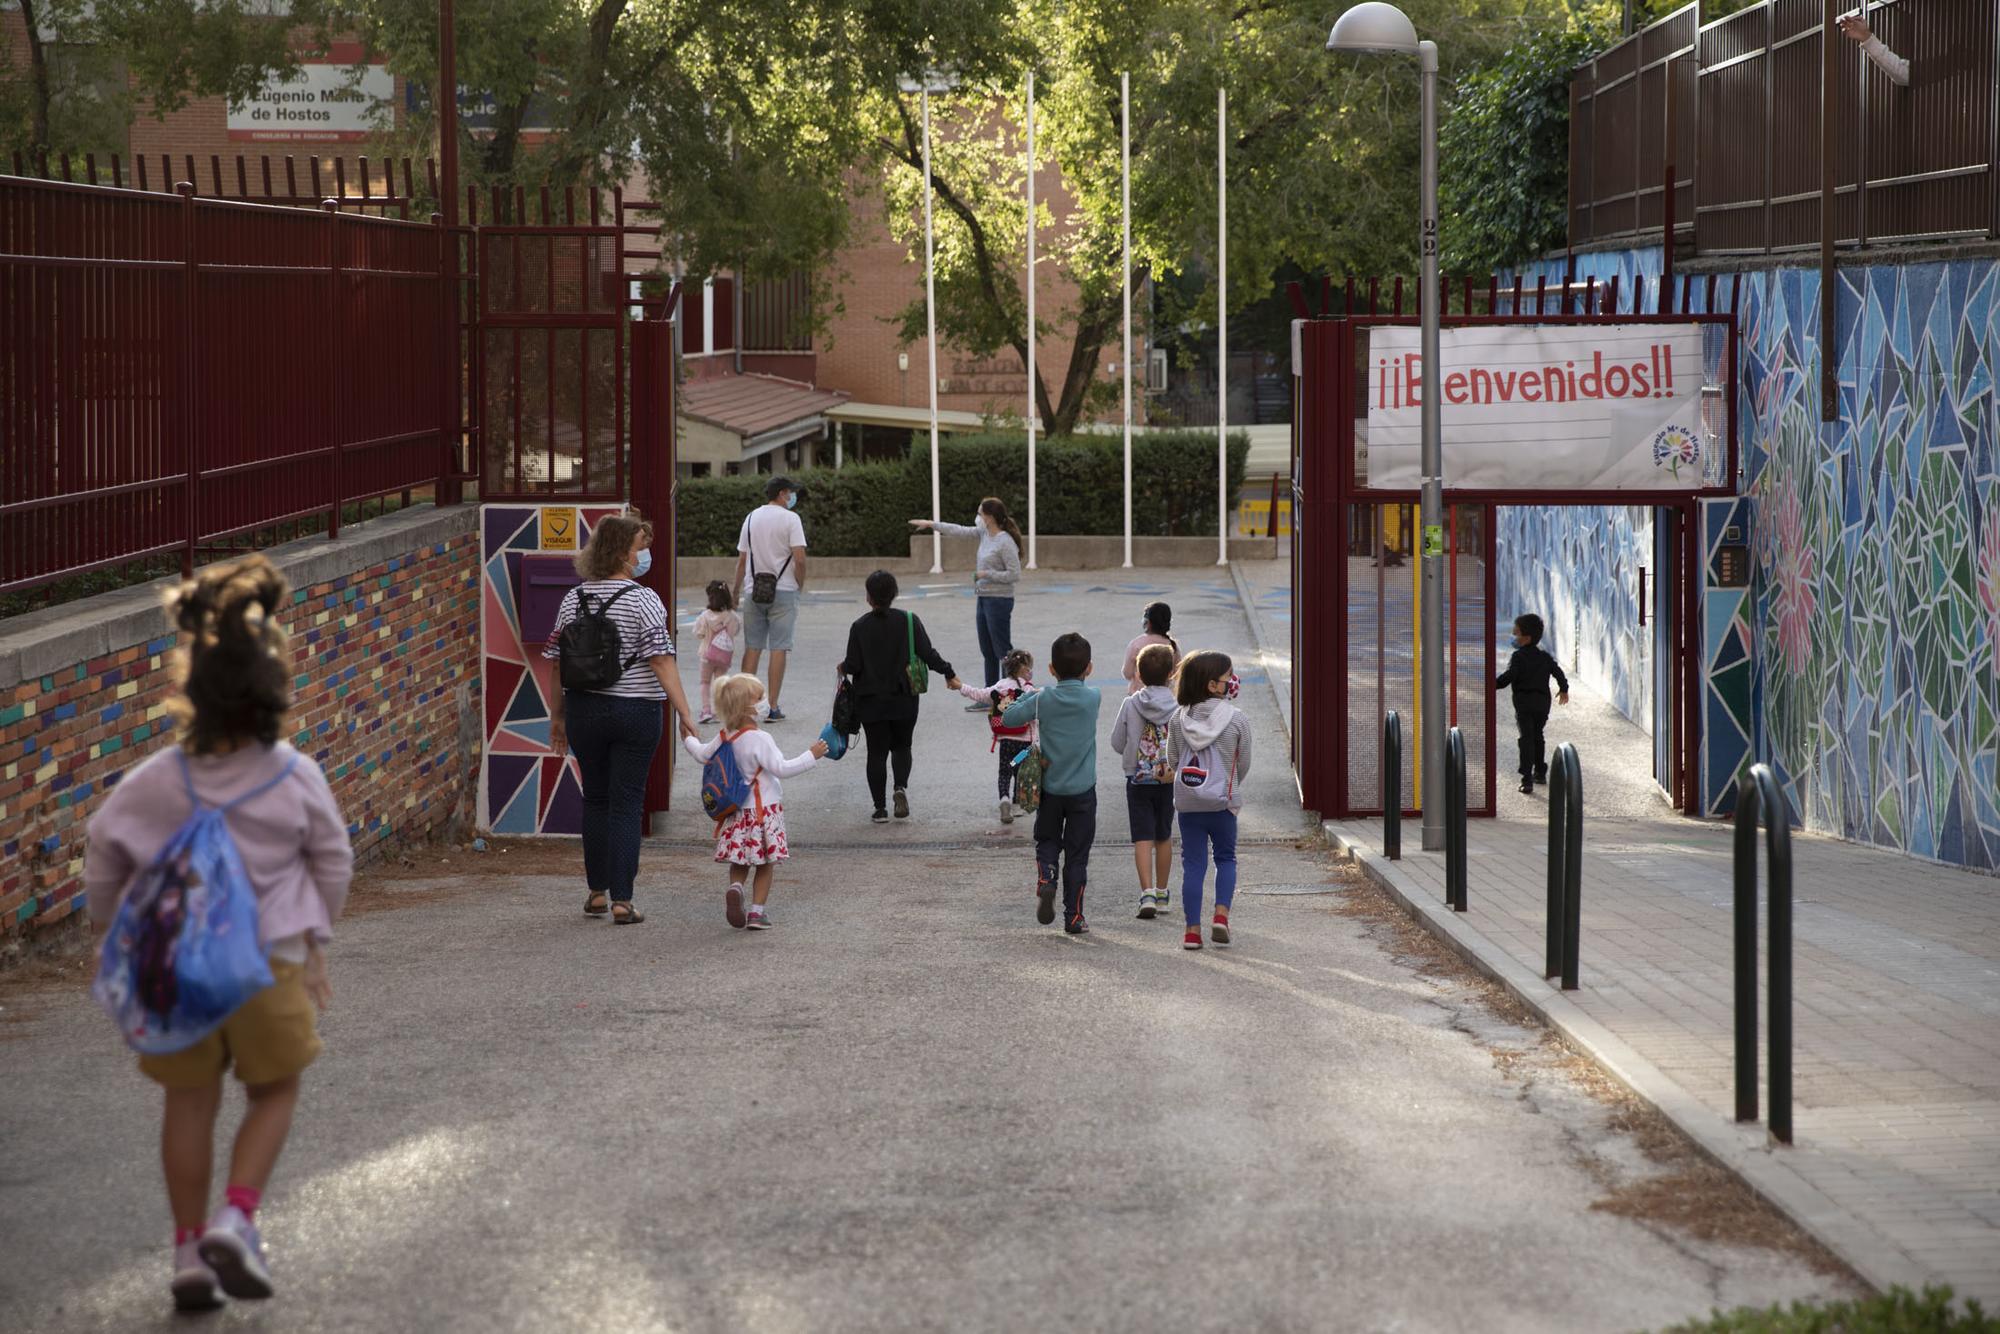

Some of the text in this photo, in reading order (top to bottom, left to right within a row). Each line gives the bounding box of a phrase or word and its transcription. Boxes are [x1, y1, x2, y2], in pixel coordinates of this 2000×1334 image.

[252, 108, 331, 121] de Hostos
[1379, 344, 1674, 410] ¡¡Benvenidos!!
